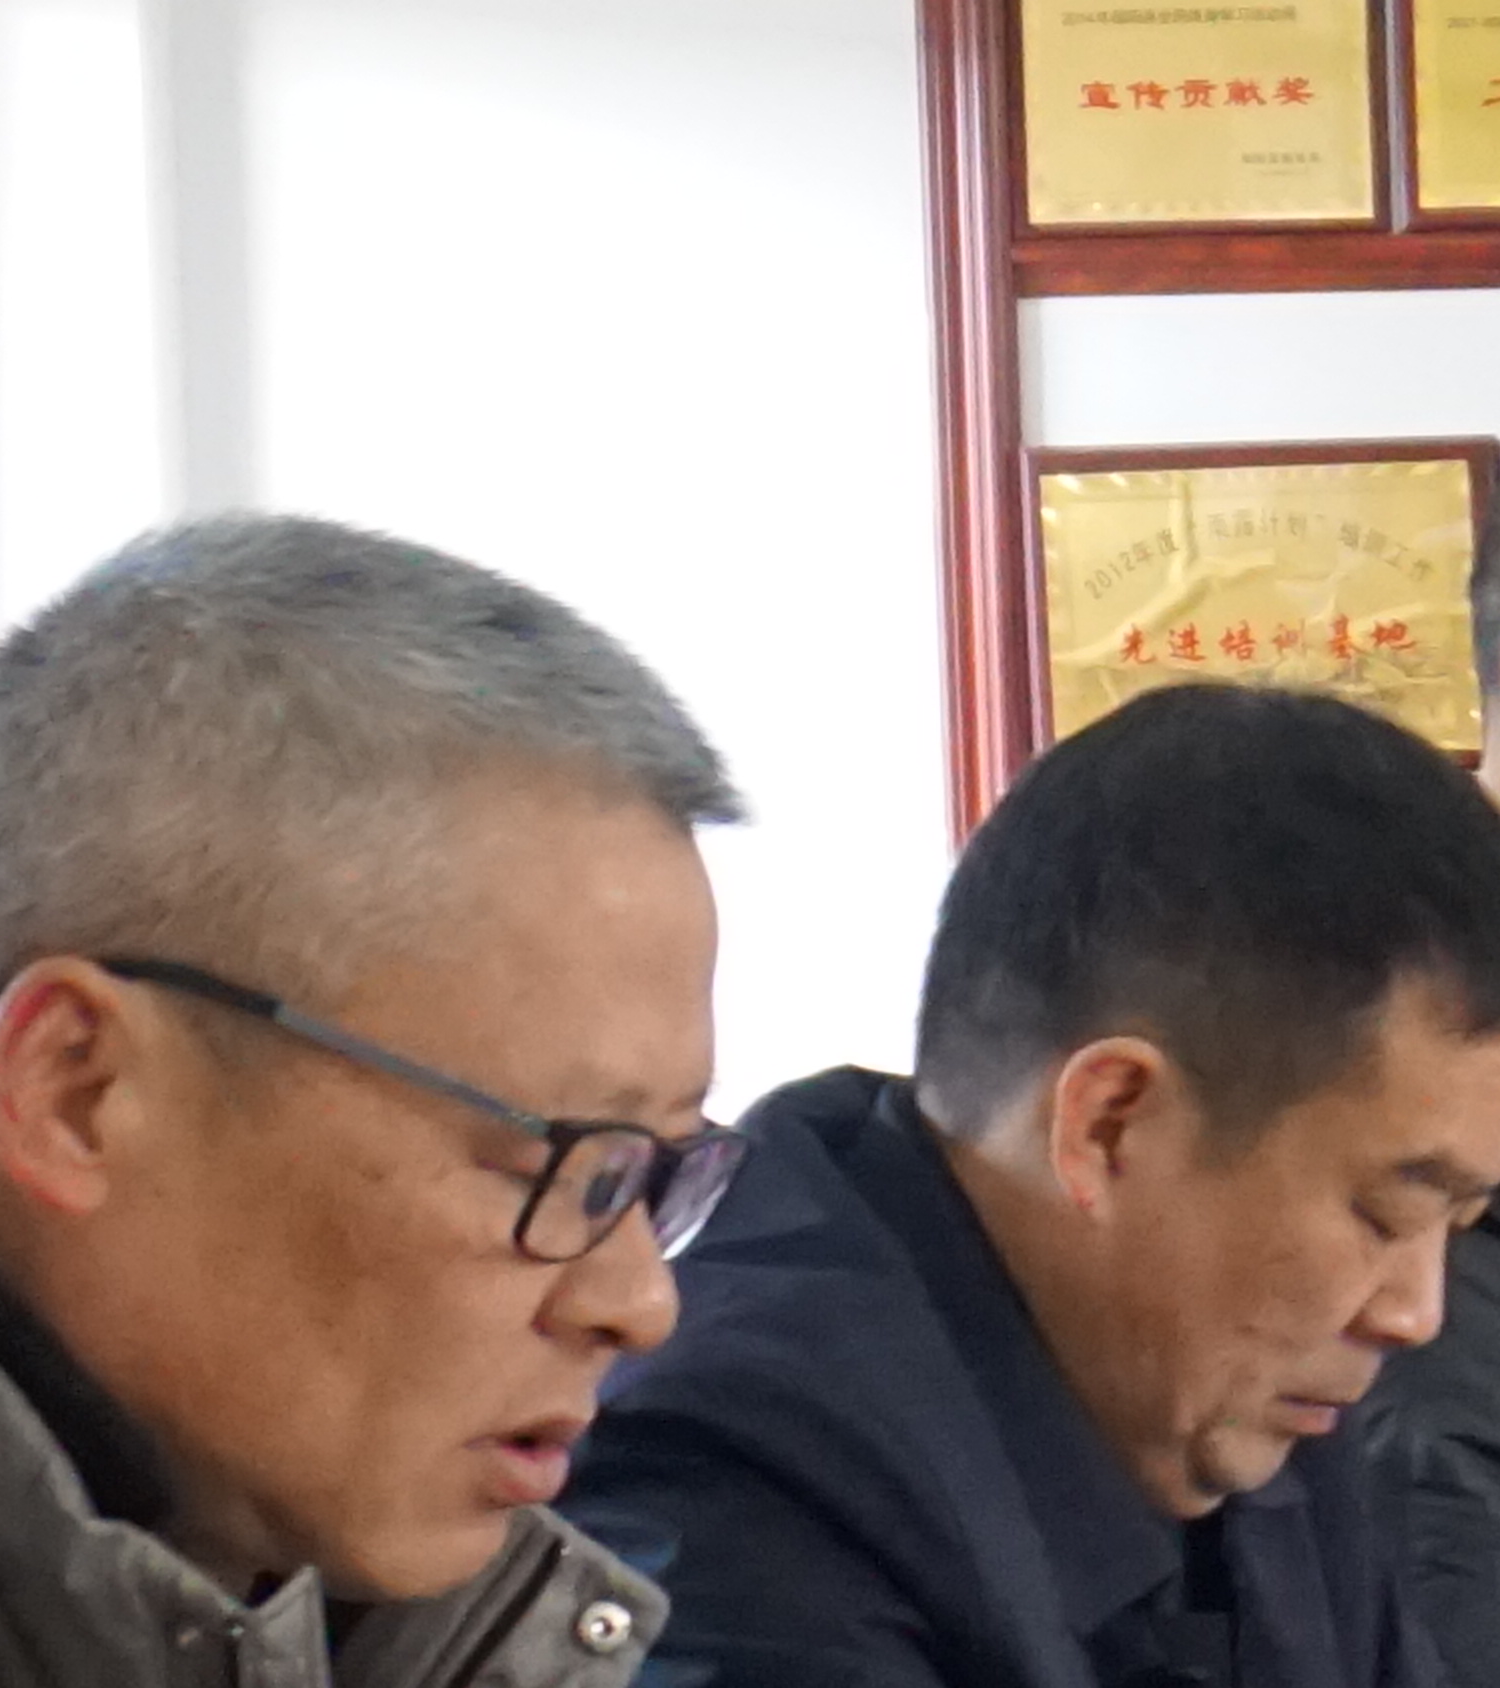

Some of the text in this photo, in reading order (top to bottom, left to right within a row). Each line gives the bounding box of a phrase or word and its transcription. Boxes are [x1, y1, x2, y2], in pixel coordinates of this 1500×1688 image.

[1080, 77, 1314, 110] 宣传贡献奖
[1120, 613, 1417, 664] 先进培训基地
